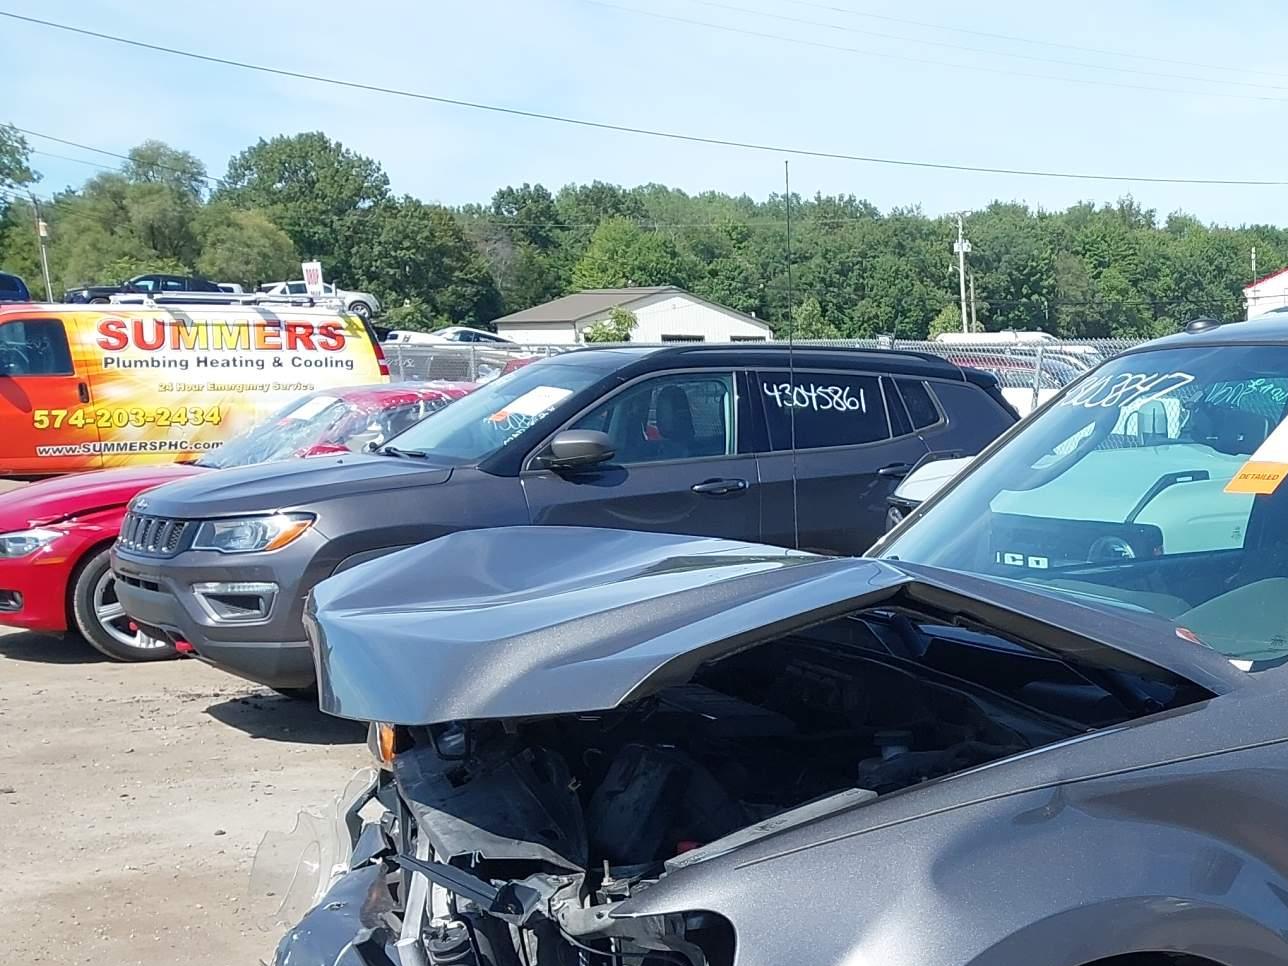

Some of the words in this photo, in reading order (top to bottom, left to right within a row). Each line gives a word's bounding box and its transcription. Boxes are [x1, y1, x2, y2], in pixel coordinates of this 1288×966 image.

[96, 318, 346, 351] SUMMERS
[103, 356, 189, 371] Plumbing
[196, 356, 265, 371] Heating
[272, 357, 283, 368] &
[291, 356, 354, 371] Cooling
[158, 383, 173, 392] 24
[176, 383, 204, 392] Hour
[207, 382, 270, 393] Emergency
[272, 382, 315, 392] Service
[763, 382, 866, 413] 43045861
[33, 407, 221, 429] 574-203-2434
[1238, 473, 1280, 481] DETAILED
